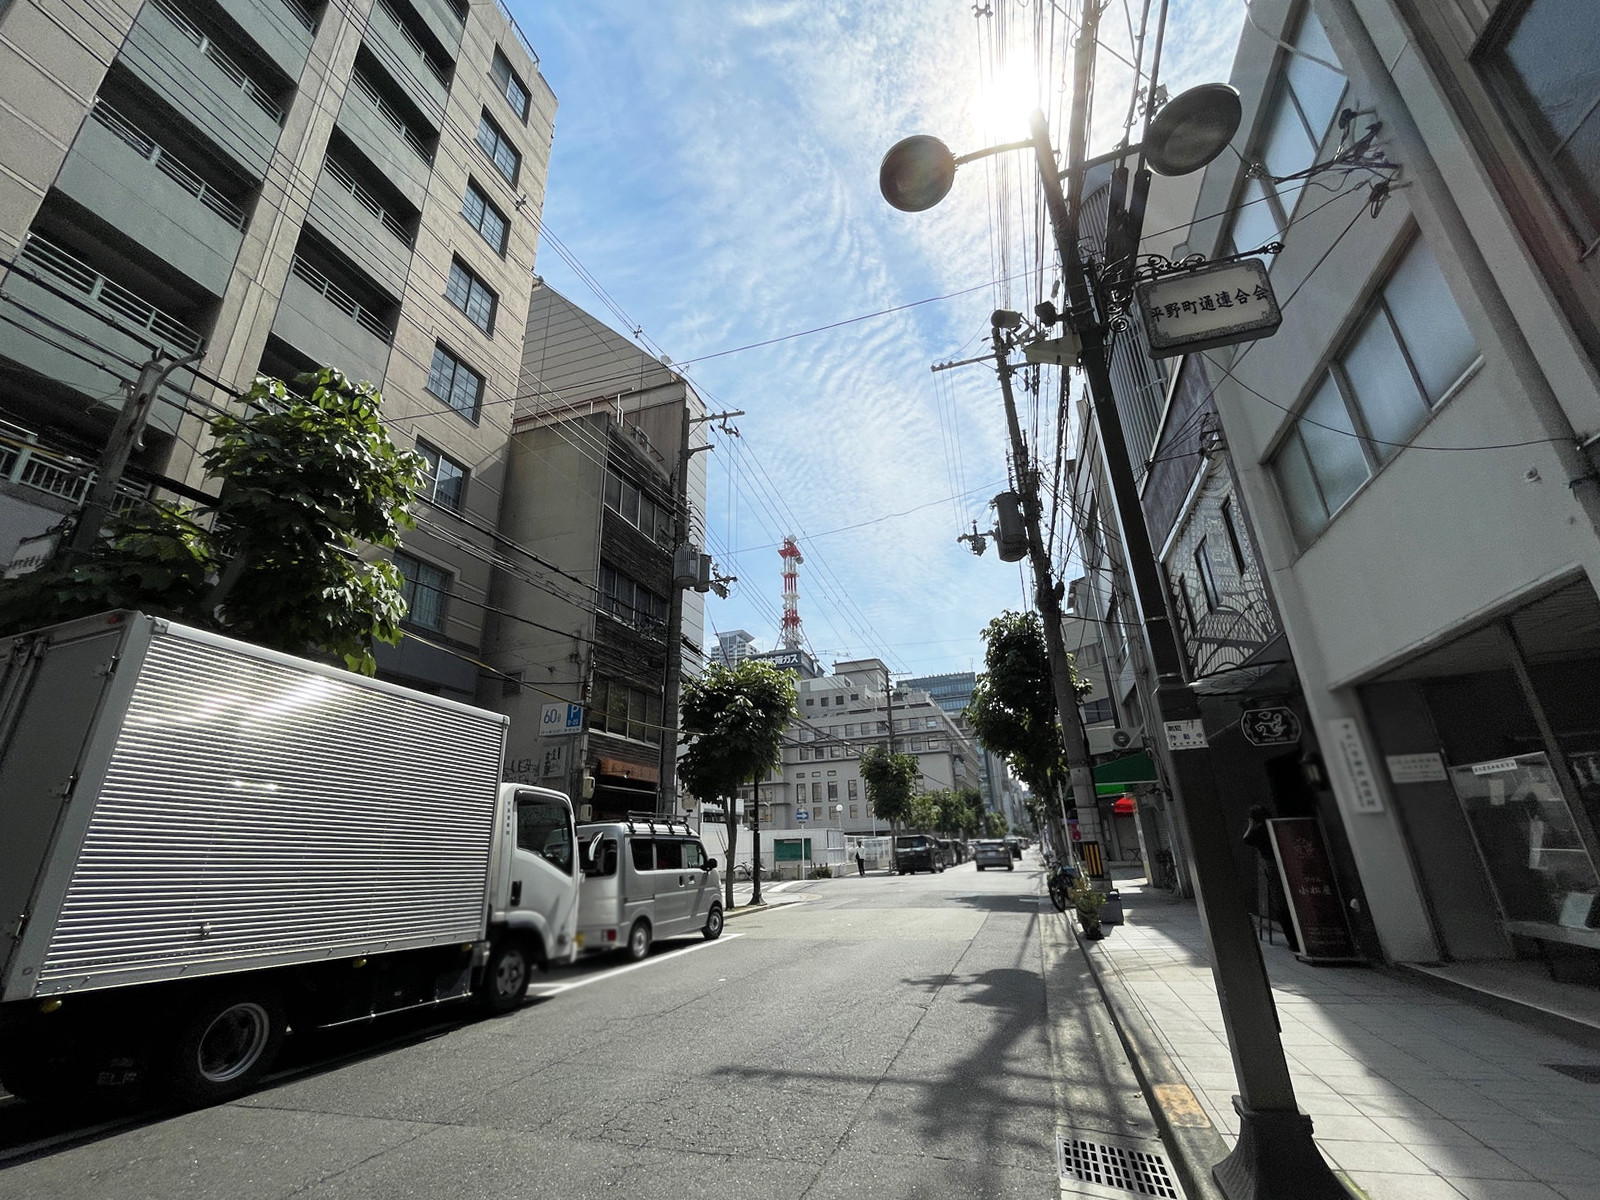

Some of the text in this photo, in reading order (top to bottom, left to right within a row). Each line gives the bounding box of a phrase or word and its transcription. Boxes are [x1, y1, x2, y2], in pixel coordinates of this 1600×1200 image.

[1150, 284, 1270, 322] 平野町通連合会
[571, 704, 579, 718] P
